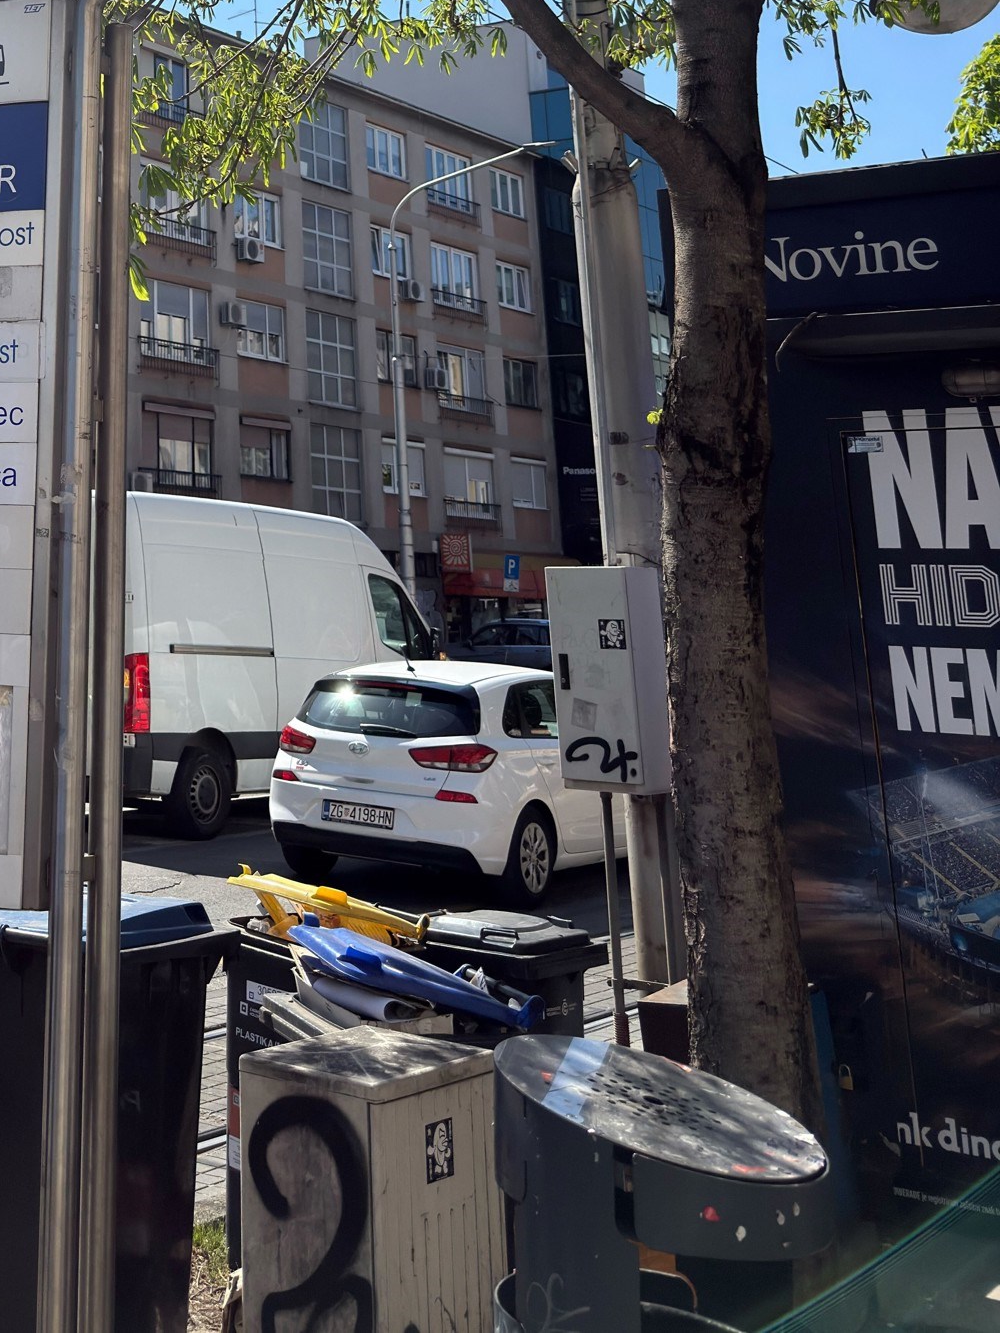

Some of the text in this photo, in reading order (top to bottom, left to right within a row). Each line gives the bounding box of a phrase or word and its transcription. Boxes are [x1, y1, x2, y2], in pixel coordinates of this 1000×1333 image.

[23, 2, 47, 14] ZET
[764, 230, 939, 283] Novine
[862, 406, 1000, 549] NA
[330, 804, 343, 818] ZG
[896, 1111, 933, 1148] nk
